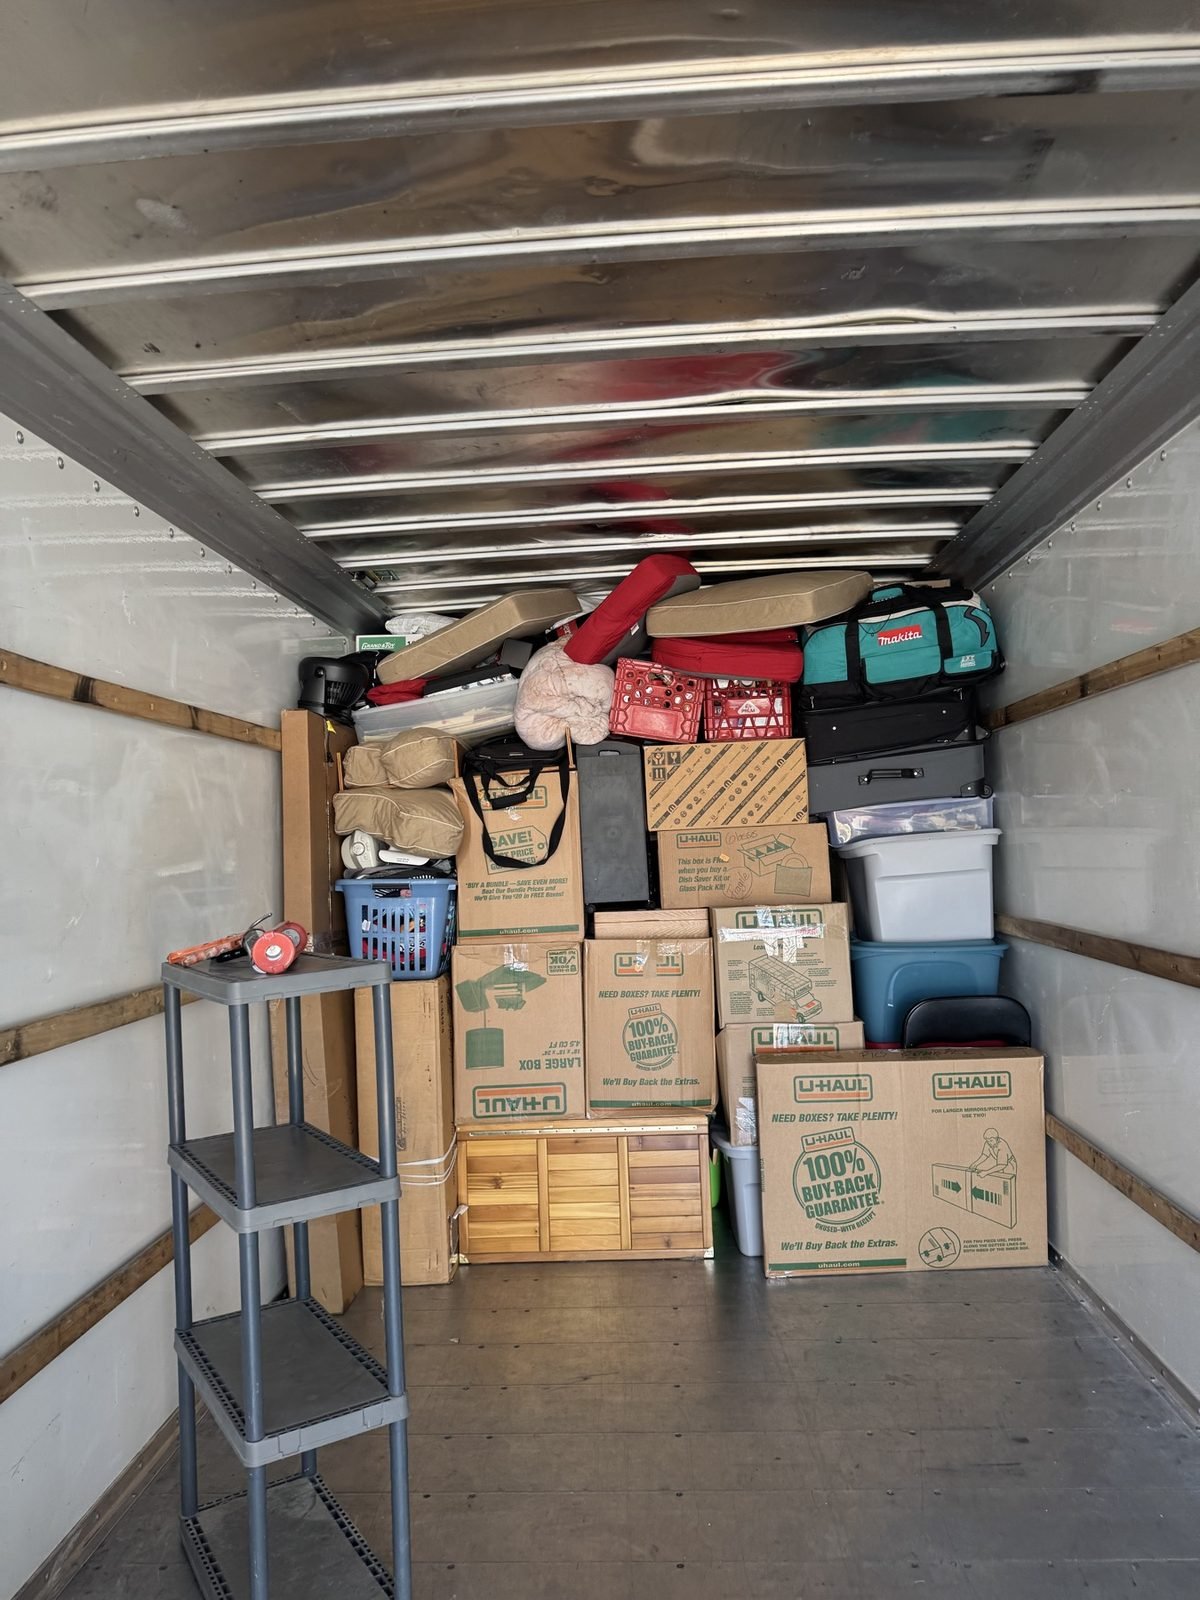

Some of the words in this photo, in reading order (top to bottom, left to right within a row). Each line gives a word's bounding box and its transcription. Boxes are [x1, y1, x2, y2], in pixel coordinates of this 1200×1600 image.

[878, 631, 922, 646] makita
[511, 847, 534, 857] PRICE
[679, 884, 696, 892] Glass
[698, 883, 713, 891] Pack
[598, 990, 618, 998] NEED
[620, 990, 648, 998] BOXES?
[651, 990, 669, 998] TAKE
[671, 989, 701, 998] PLENTY!
[629, 1016, 668, 1038] 100%
[628, 1033, 674, 1051] BUY-BACK
[630, 1046, 677, 1062] GUARANTEE
[519, 1060, 541, 1070] BOX
[545, 1057, 581, 1069] LARGE
[602, 1078, 621, 1086] We'll
[623, 1078, 637, 1087] Buy
[640, 1078, 658, 1086] Back
[799, 1079, 868, 1092] U-HAUL
[938, 1076, 1006, 1089] U-HAUL
[479, 1095, 560, 1113] U-HAUL
[772, 1113, 796, 1123] NEED
[799, 1112, 834, 1122] BOXES?
[837, 1112, 859, 1121] TAKE
[861, 1111, 898, 1120] PLENTY!
[804, 1129, 852, 1146] U-HAUL
[803, 1148, 865, 1181] 100%
[801, 1173, 876, 1202] BUY-BACK
[805, 1191, 880, 1219] GUARANTEE
[781, 1241, 802, 1251] We'll
[805, 1241, 822, 1251] Buy
[825, 1240, 847, 1249] Back
[850, 1239, 864, 1248] the
[867, 1239, 898, 1248] Extras.
[818, 1261, 860, 1269] uhaul.com
